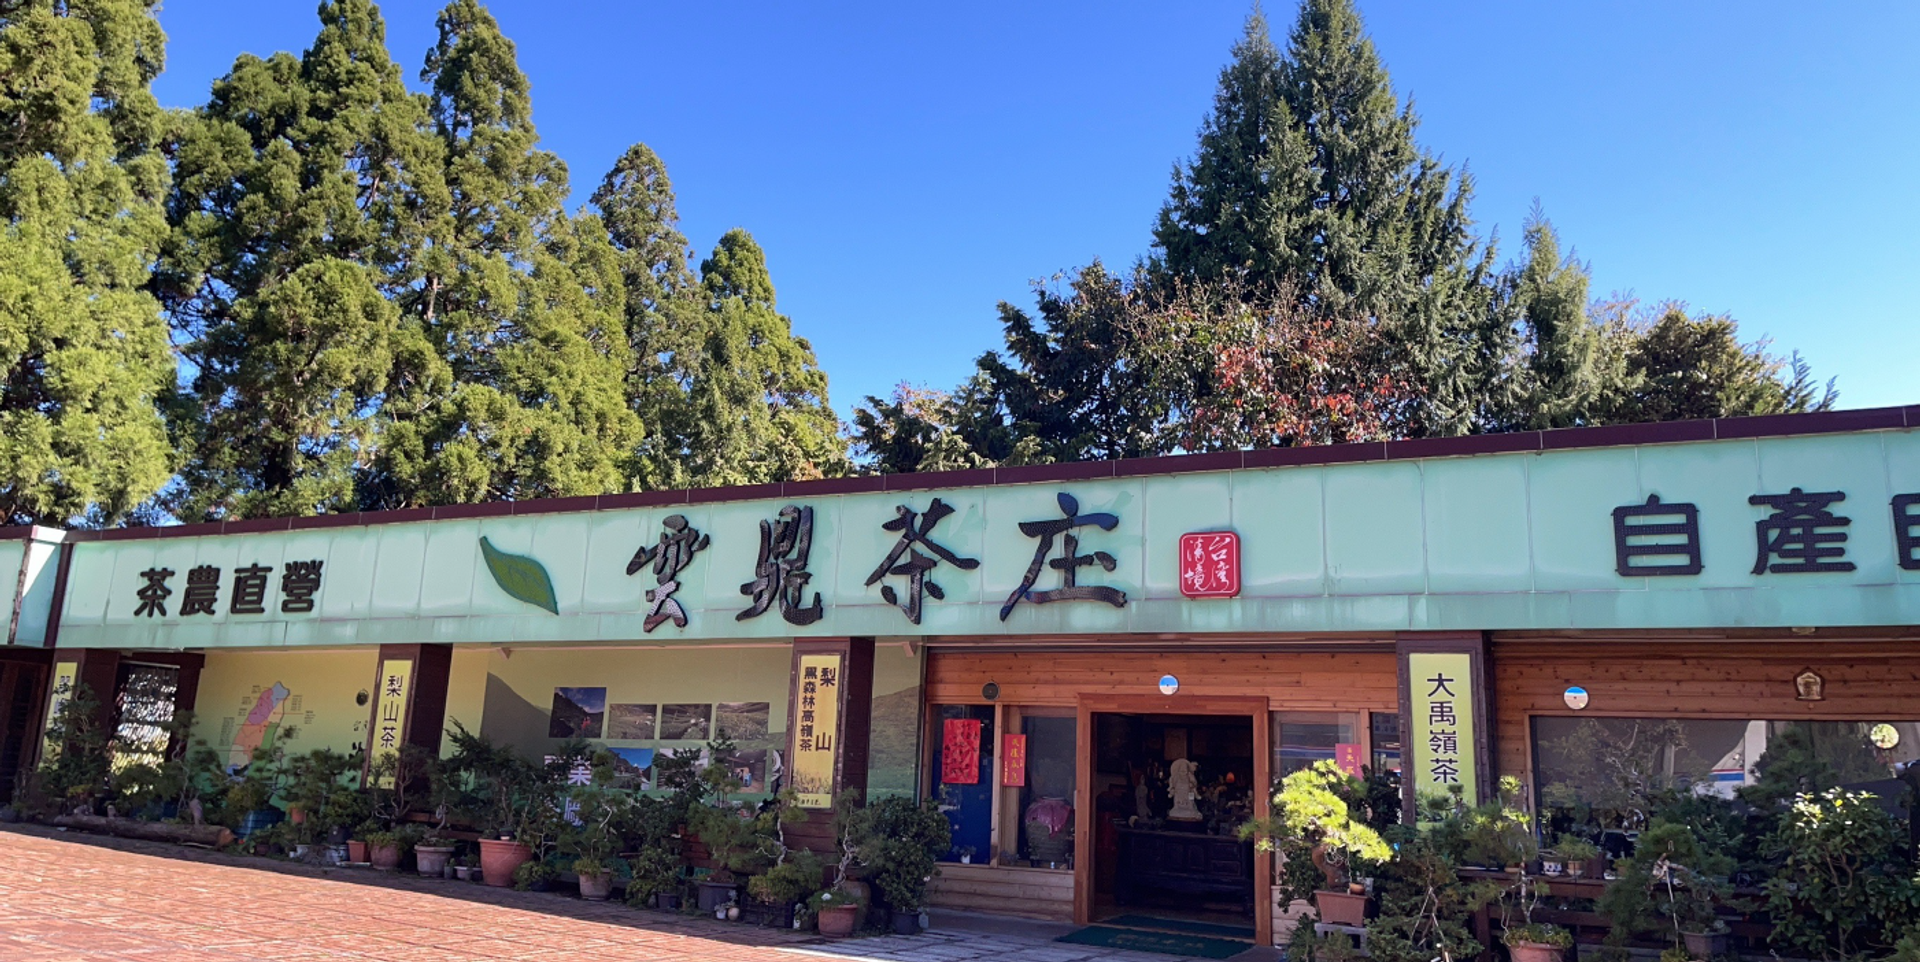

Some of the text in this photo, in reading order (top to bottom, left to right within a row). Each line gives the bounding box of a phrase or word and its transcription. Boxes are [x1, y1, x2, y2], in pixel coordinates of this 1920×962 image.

[133, 559, 324, 618] 茶農直營
[1184, 537, 1208, 591] 清境
[1208, 536, 1232, 592] 台灣
[380, 674, 404, 749] 梨山茶
[815, 667, 837, 752] 梨山
[1426, 672, 1459, 784] 大禹嶺茶
